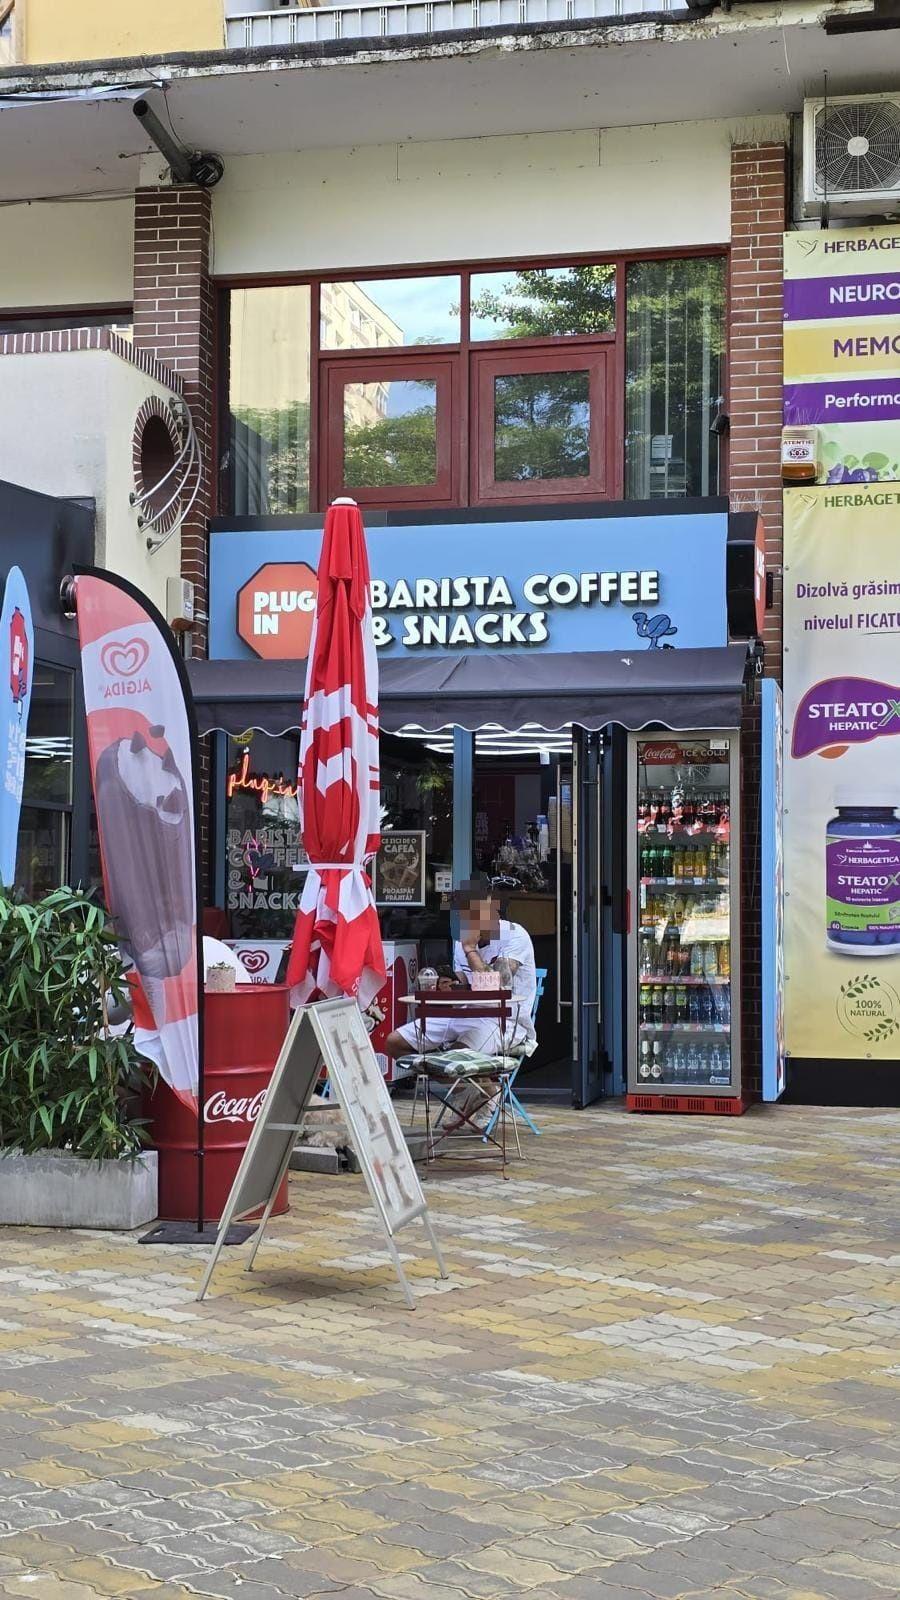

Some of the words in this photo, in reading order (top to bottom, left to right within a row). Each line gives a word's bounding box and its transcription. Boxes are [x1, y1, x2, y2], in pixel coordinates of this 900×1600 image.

[824, 237, 900, 254] HERBAGE
[829, 282, 900, 304] NEURO
[370, 575, 515, 610] BARISTA
[523, 570, 659, 605] COFFEE
[796, 581, 848, 599] Dizolvă
[254, 590, 317, 613] PLUG
[253, 613, 279, 635] IN
[372, 616, 394, 646] &
[402, 611, 549, 646] SNACKS
[804, 614, 853, 631] nivelul
[829, 721, 879, 731] HEPATIC
[682, 749, 699, 757] ICE
[701, 748, 726, 757] COLD
[850, 1009, 887, 1017] NATURAL
[855, 1000, 882, 1009] 100%
[203, 1089, 268, 1124] Coca-C
